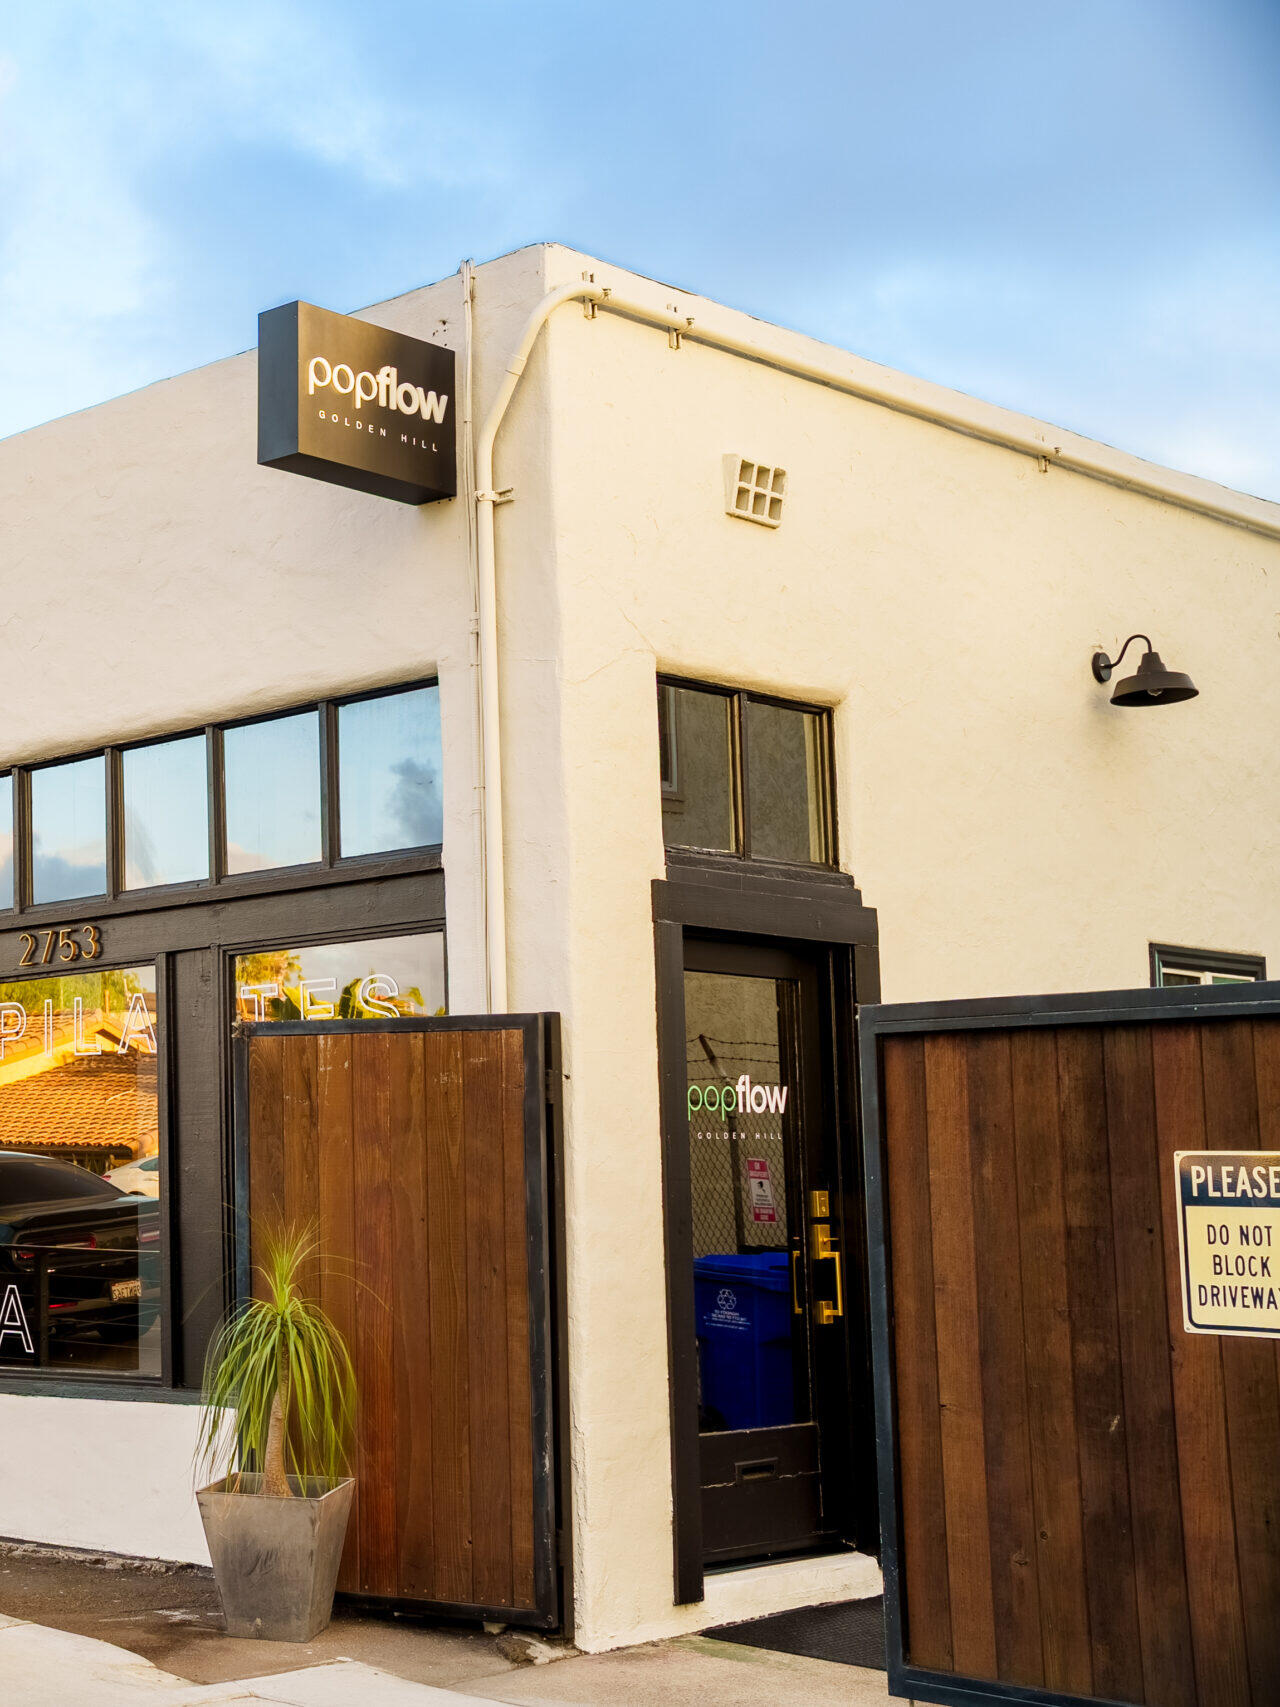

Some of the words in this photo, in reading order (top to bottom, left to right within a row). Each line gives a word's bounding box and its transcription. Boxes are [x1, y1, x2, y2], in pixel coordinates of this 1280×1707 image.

[308, 356, 448, 424] popflow
[318, 409, 387, 437] GOLDEN
[400, 433, 438, 452] HILL
[19, 925, 99, 966] 2753
[687, 1074, 788, 1121] popflow
[697, 1131, 746, 1140] GOLDEN
[755, 1131, 782, 1140] HILL
[1191, 1165, 1280, 1198] PLEASE
[1207, 1224, 1230, 1245] DO
[1239, 1225, 1272, 1247] NOT
[1213, 1254, 1271, 1277] BLOCK
[1198, 1284, 1280, 1310] DRIVEWA
